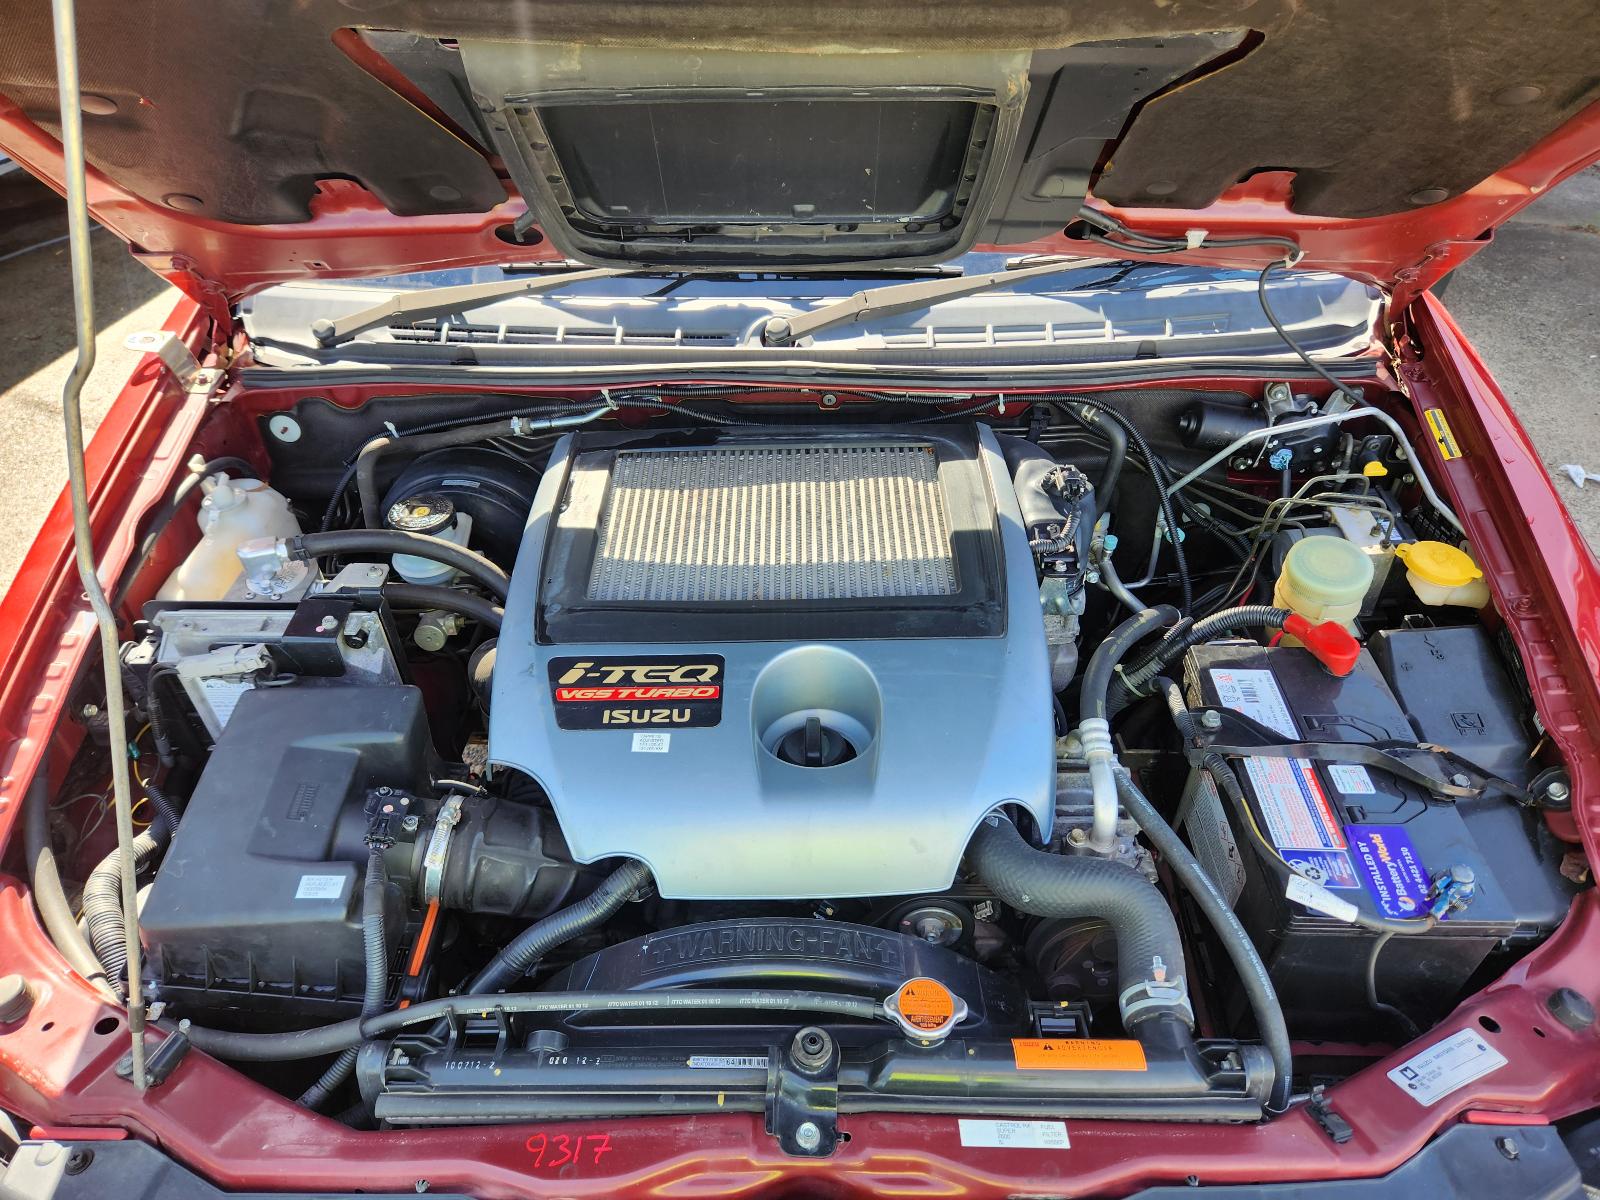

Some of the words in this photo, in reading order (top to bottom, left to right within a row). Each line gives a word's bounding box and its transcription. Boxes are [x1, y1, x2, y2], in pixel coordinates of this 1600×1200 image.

[561, 689, 615, 699] VGS
[618, 687, 715, 699] TURBO
[602, 708, 691, 724] ISUZU
[1357, 841, 1370, 853] BY
[1363, 854, 1392, 901] INSTALLED
[1408, 864, 1423, 883] 4421
[1417, 883, 1428, 894] 02
[526, 1132, 614, 1168] 9317
